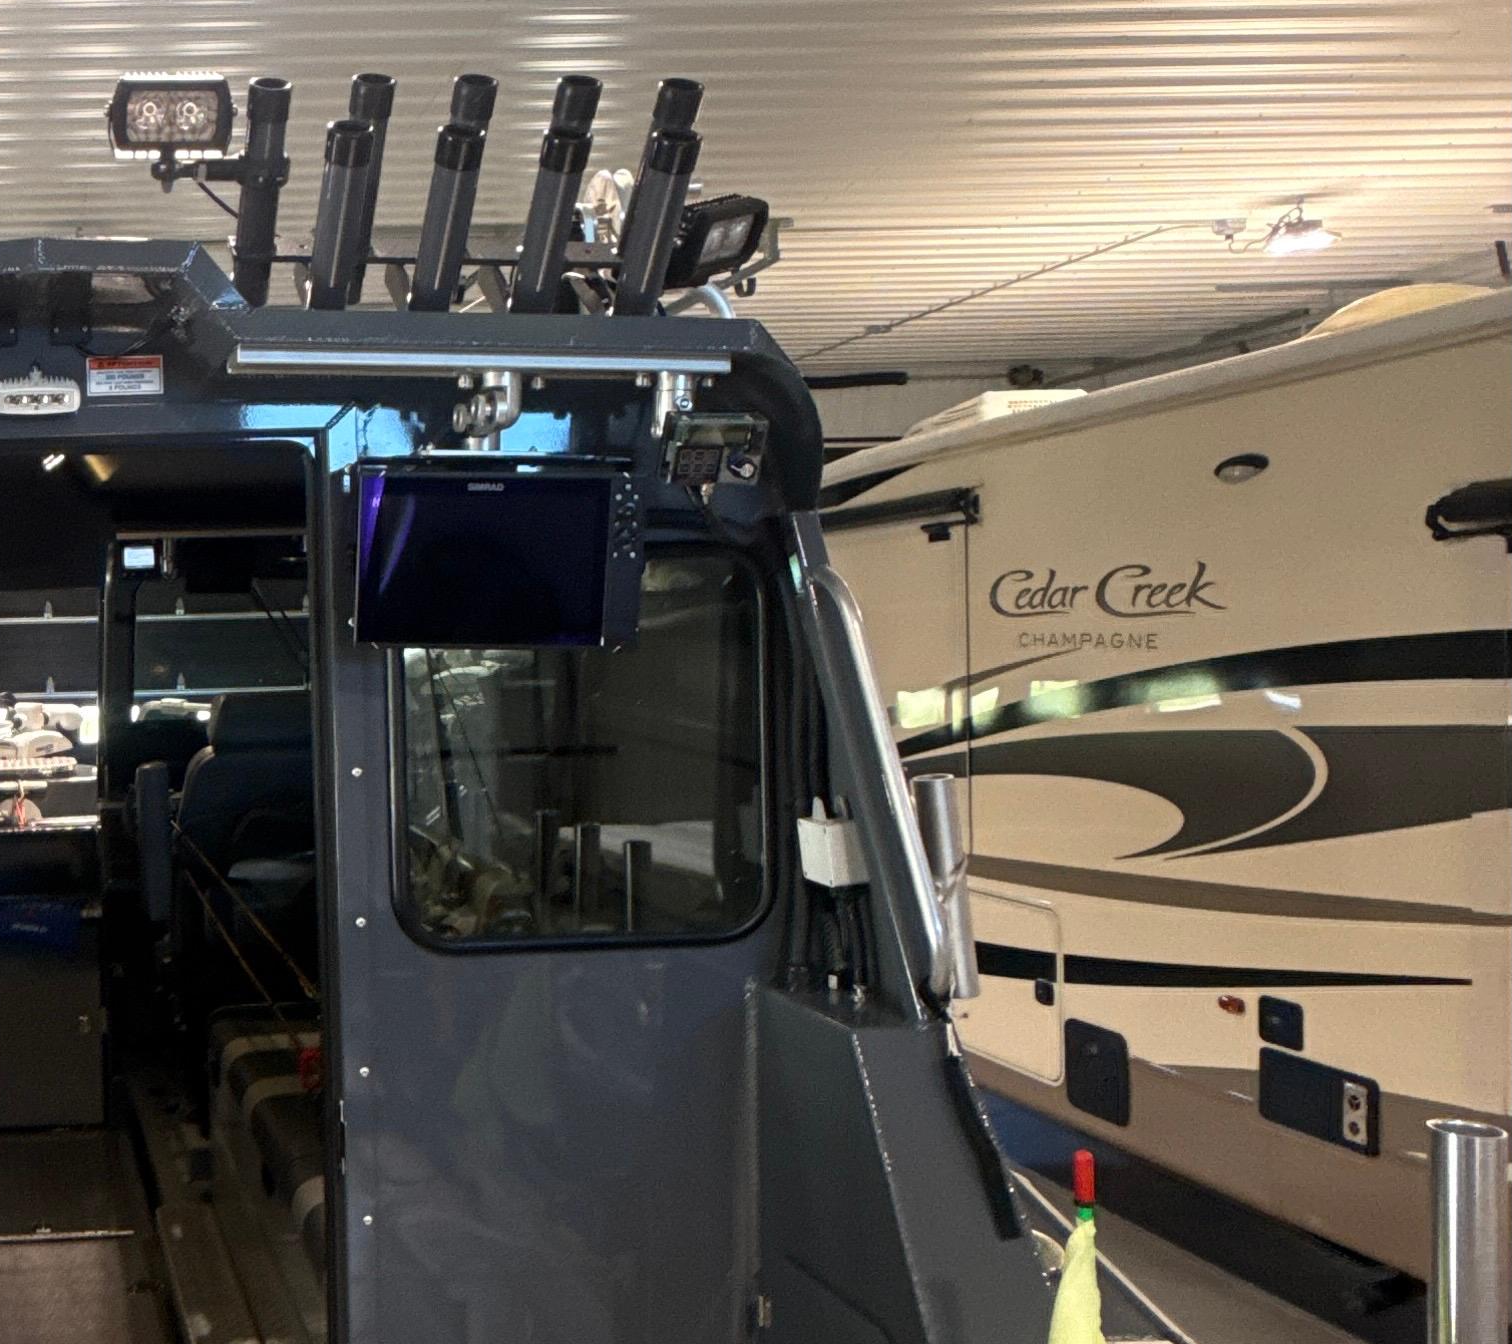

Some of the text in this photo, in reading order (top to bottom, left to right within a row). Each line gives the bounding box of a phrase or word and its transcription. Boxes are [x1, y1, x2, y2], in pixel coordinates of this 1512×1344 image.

[989, 561, 1227, 618] Cedar Creek
[1019, 632, 1159, 650] CHAMPAGNE
